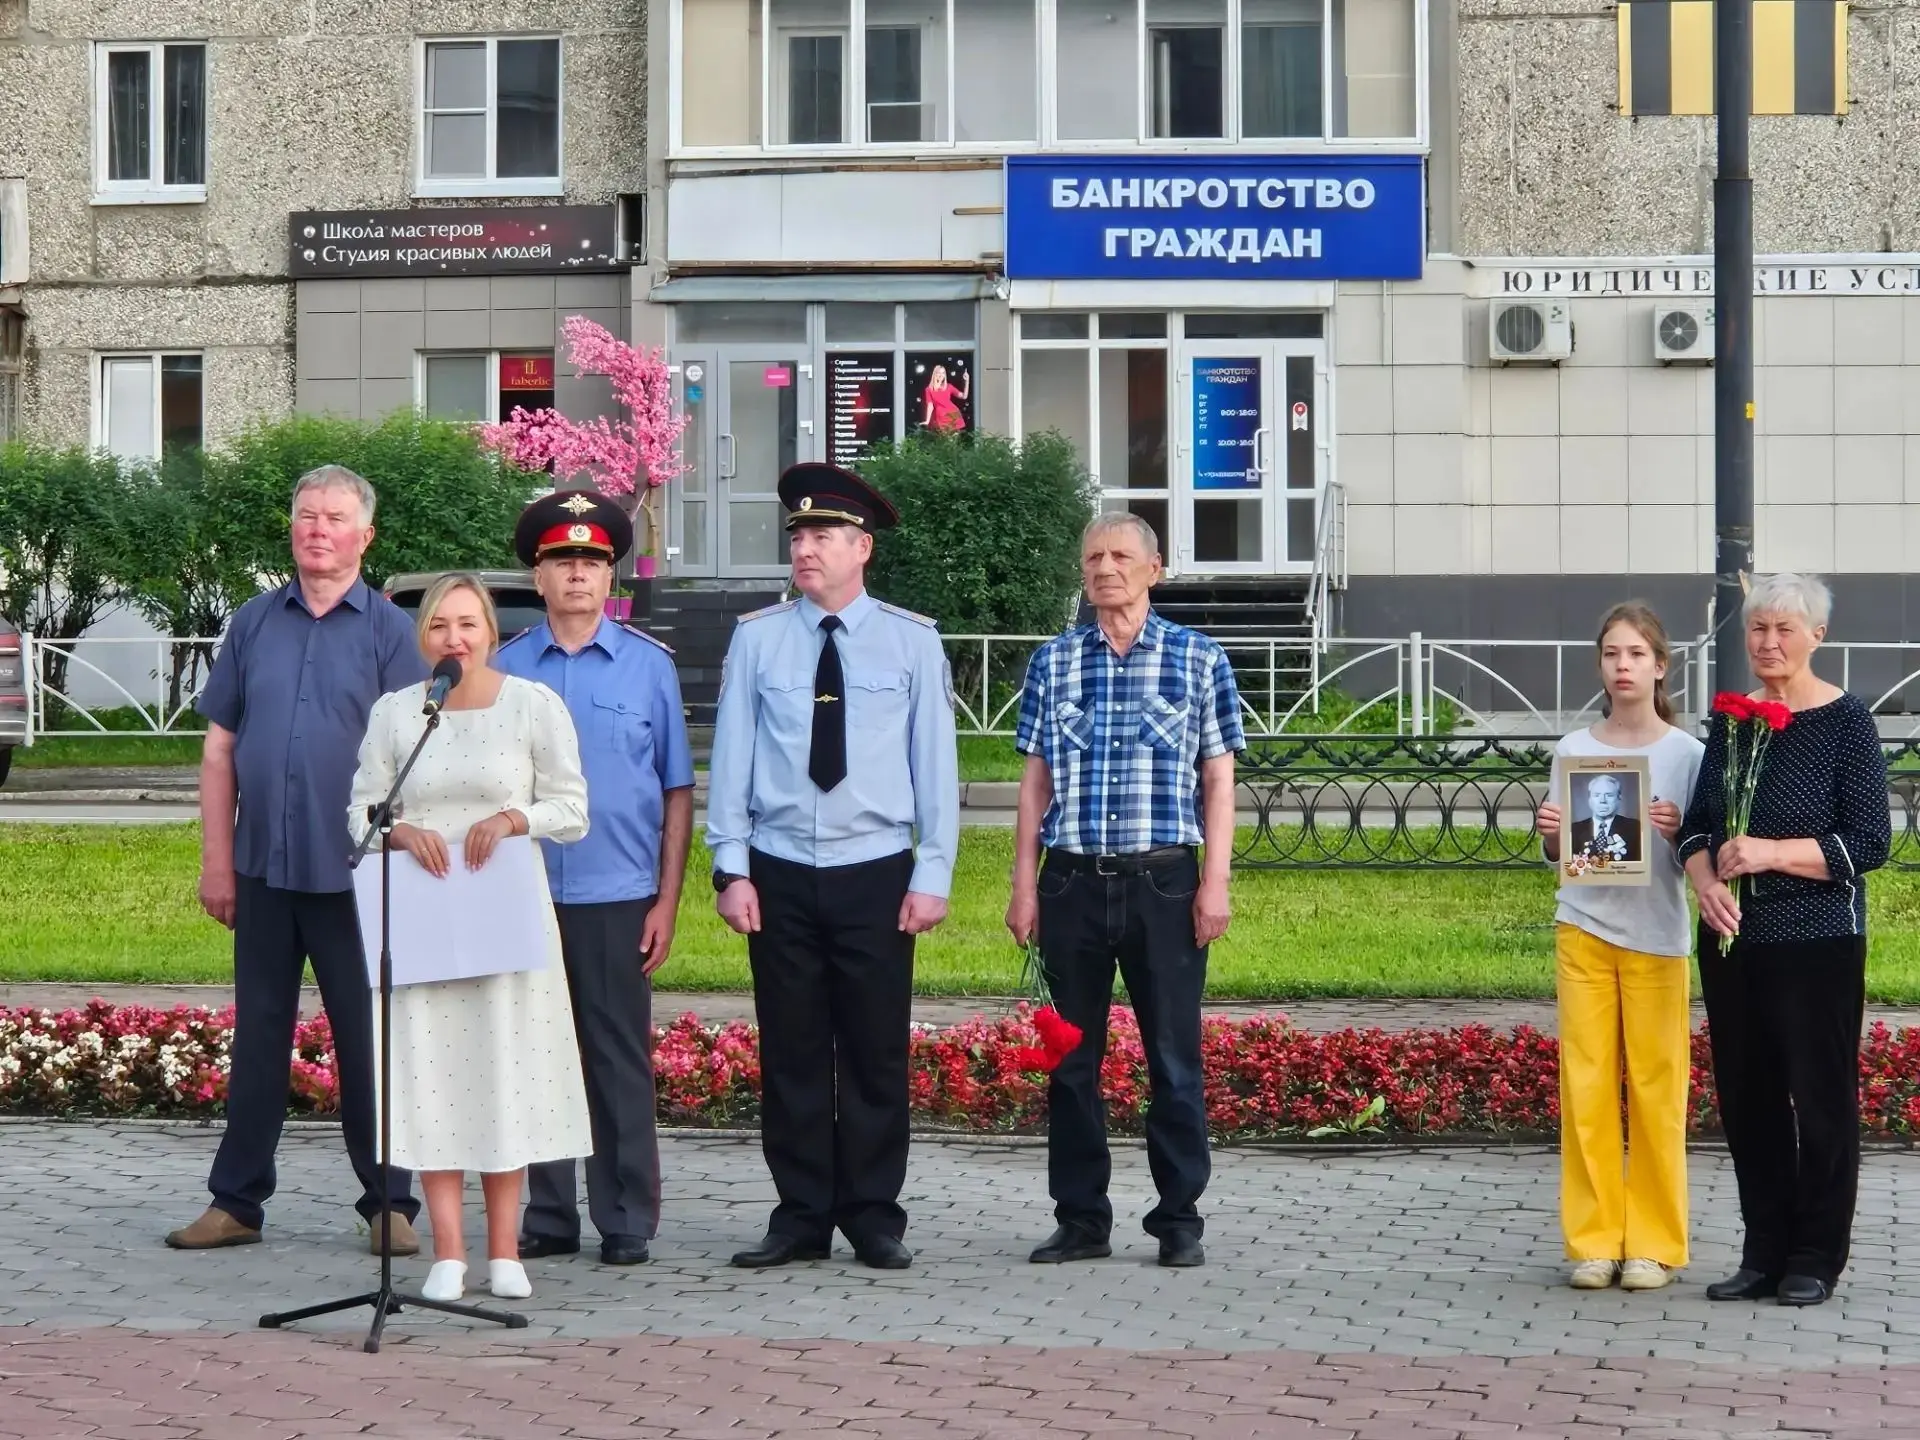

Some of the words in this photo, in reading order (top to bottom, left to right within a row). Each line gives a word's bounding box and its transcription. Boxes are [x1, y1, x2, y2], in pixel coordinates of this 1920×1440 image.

[1051, 177, 1376, 209] БАНКРОТСТВО
[322, 223, 385, 240] Школа
[391, 224, 485, 242] мастеров
[322, 245, 390, 265] Студия
[396, 247, 488, 264] красивых
[492, 243, 553, 260] людей
[1104, 228, 1323, 264] ГРАЖДАН
[1503, 268, 1828, 296] ЮРИДИЧЕКИЕ
[510, 376, 552, 385] faberlic
[1197, 367, 1257, 376] БАНКРОТСТВО
[1206, 376, 1248, 384] ГРАЖДАН
